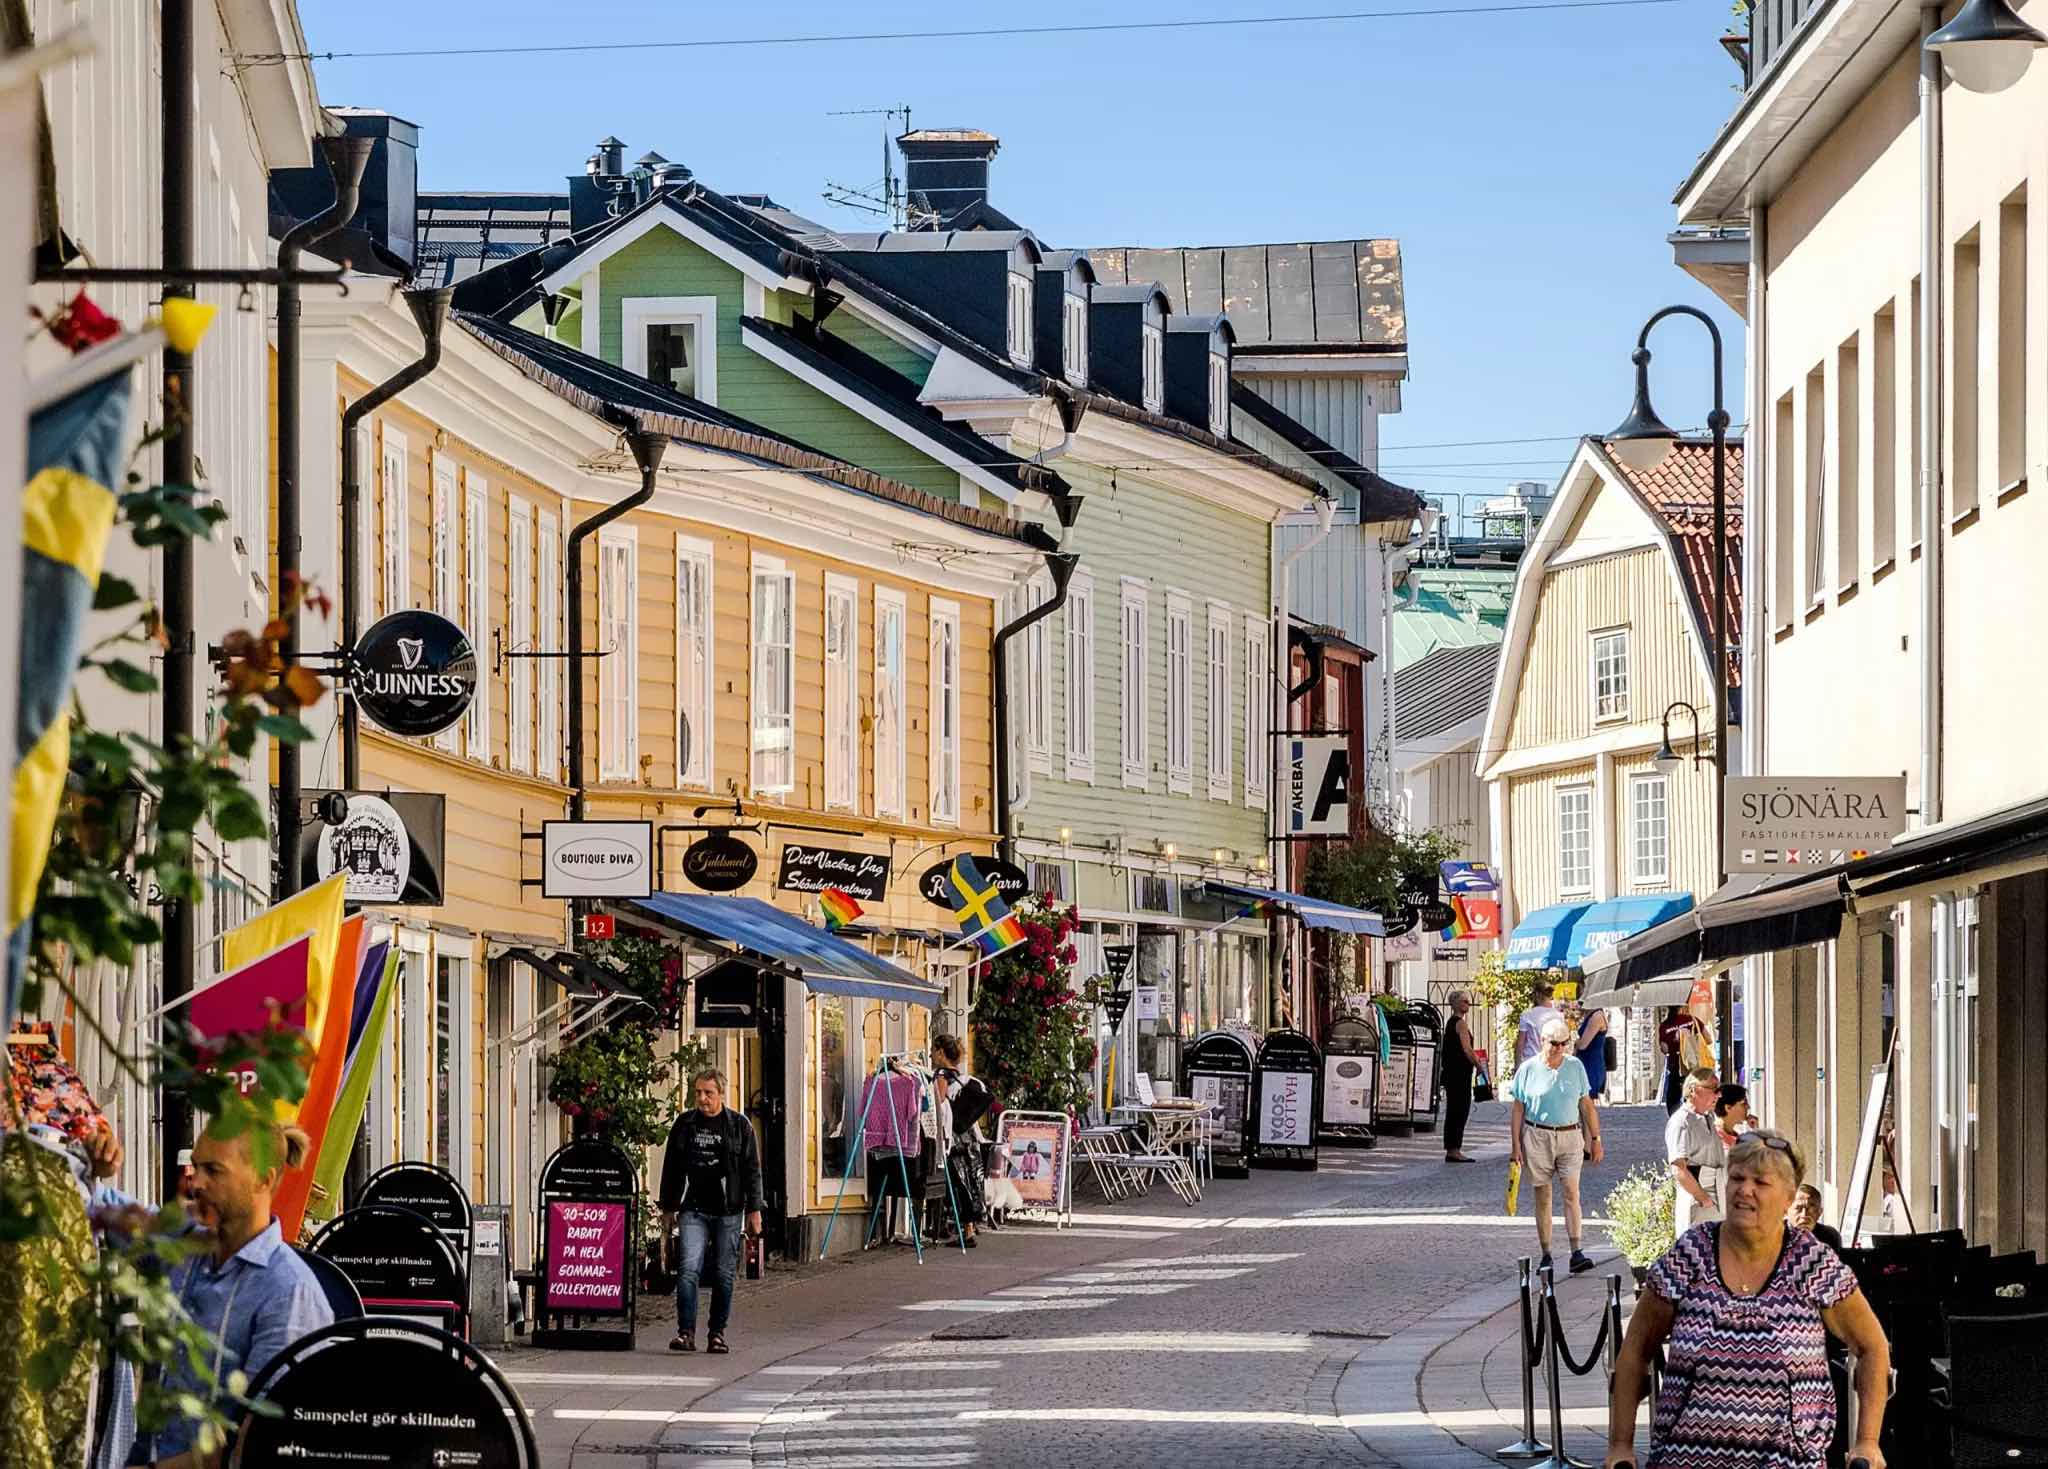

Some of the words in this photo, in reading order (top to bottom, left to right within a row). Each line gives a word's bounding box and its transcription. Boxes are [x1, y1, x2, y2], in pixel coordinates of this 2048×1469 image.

[1741, 786, 1889, 824] SJÖNÄRA
[561, 853, 606, 865] BOUTIQUE
[609, 854, 635, 865] DIVA
[785, 846, 815, 865] Ditt
[814, 851, 857, 872] Vackra
[856, 855, 885, 878] Jag
[1284, 1076, 1298, 1141] HALLON
[1271, 1094, 1285, 1141] SODA
[563, 1207, 608, 1222] 30-50%
[567, 1226, 603, 1239] RABATT
[580, 1246, 604, 1259] HELA
[332, 1255, 373, 1266] Samspelet
[375, 1256, 389, 1266] gör
[391, 1257, 432, 1266] skillnaden
[549, 1282, 621, 1297] KOLLEKTIONEN
[293, 1407, 368, 1427] Samspelet
[372, 1411, 398, 1427] gör
[401, 1412, 477, 1429] skillnaden
